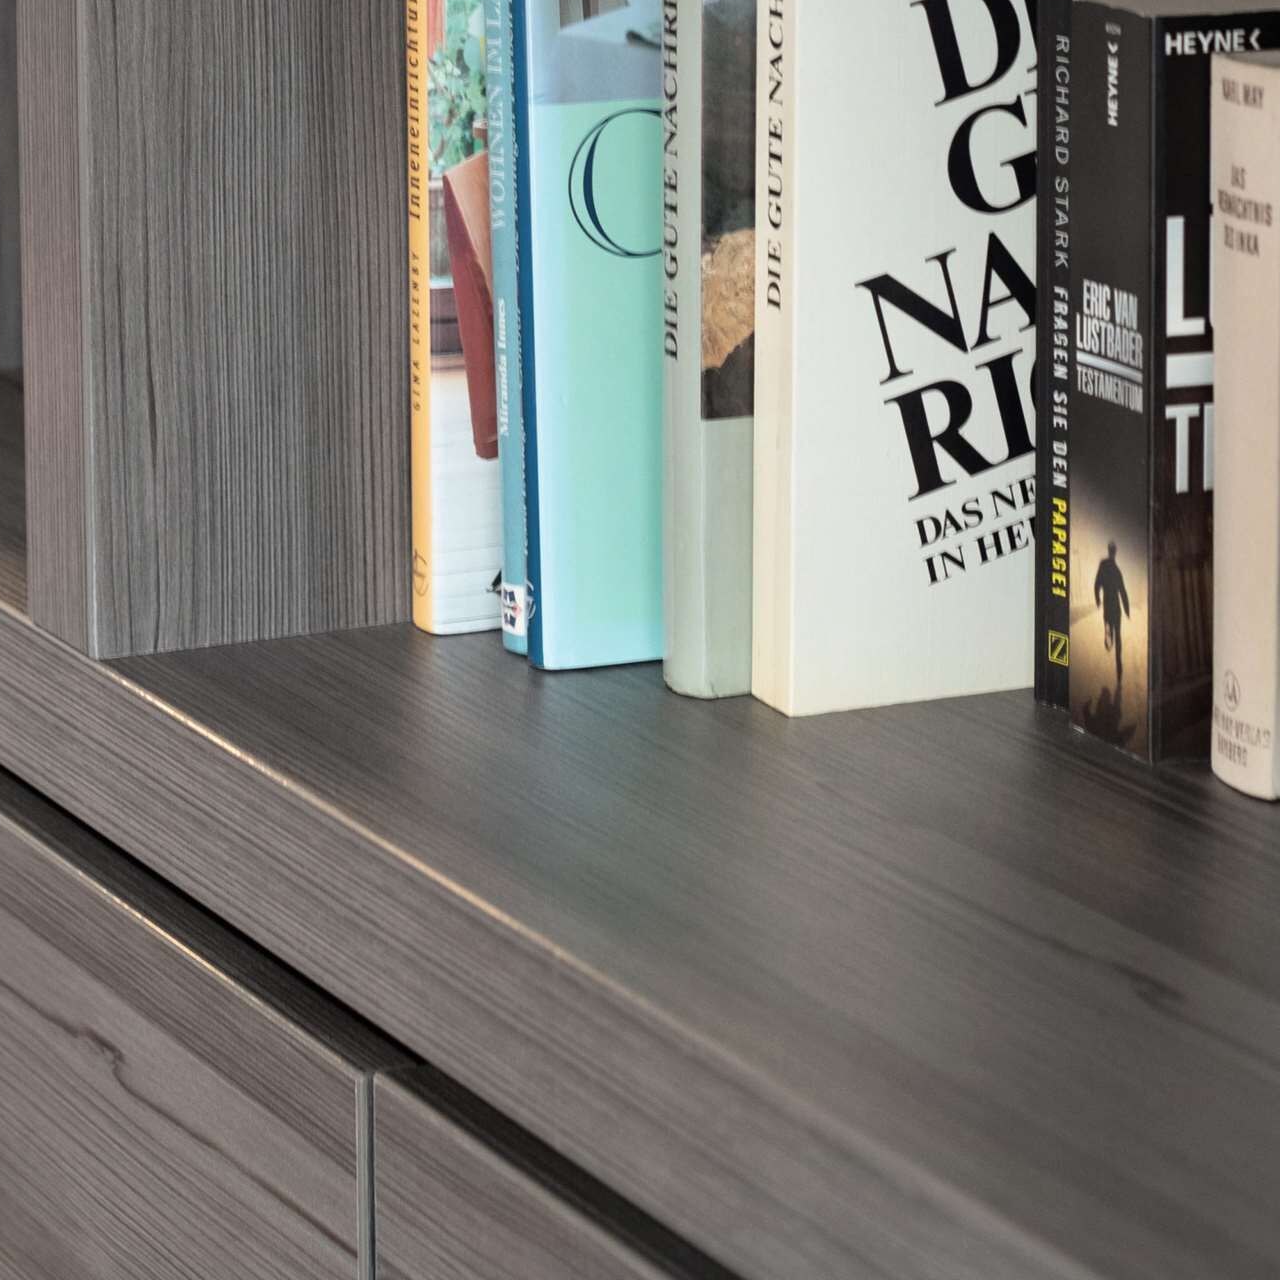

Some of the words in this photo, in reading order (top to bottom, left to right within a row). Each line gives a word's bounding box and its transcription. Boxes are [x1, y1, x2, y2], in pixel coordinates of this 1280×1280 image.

[1164, 28, 1246, 57] HEYNE
[1055, 33, 1070, 166] RICHARD
[1106, 54, 1119, 127] HEYNE
[767, 117, 784, 231] GUTE
[663, 167, 678, 281] GUTE
[1054, 175, 1070, 269] STARK
[767, 238, 783, 311] DIE
[1082, 277, 1111, 322] ERIC
[1113, 287, 1138, 331] VAN
[496, 298, 508, 350] Innes
[663, 289, 678, 361] DIE
[1053, 285, 1069, 380] FRAGEN
[1075, 311, 1143, 371] LUSTBADER
[410, 359, 421, 413] GINA
[498, 353, 510, 437] Miranda
[1052, 389, 1069, 431] SIE
[1076, 363, 1144, 415] TESTAMENTUM
[1052, 439, 1068, 489] DEN
[915, 496, 984, 549] DAS
[922, 533, 968, 587] IN
